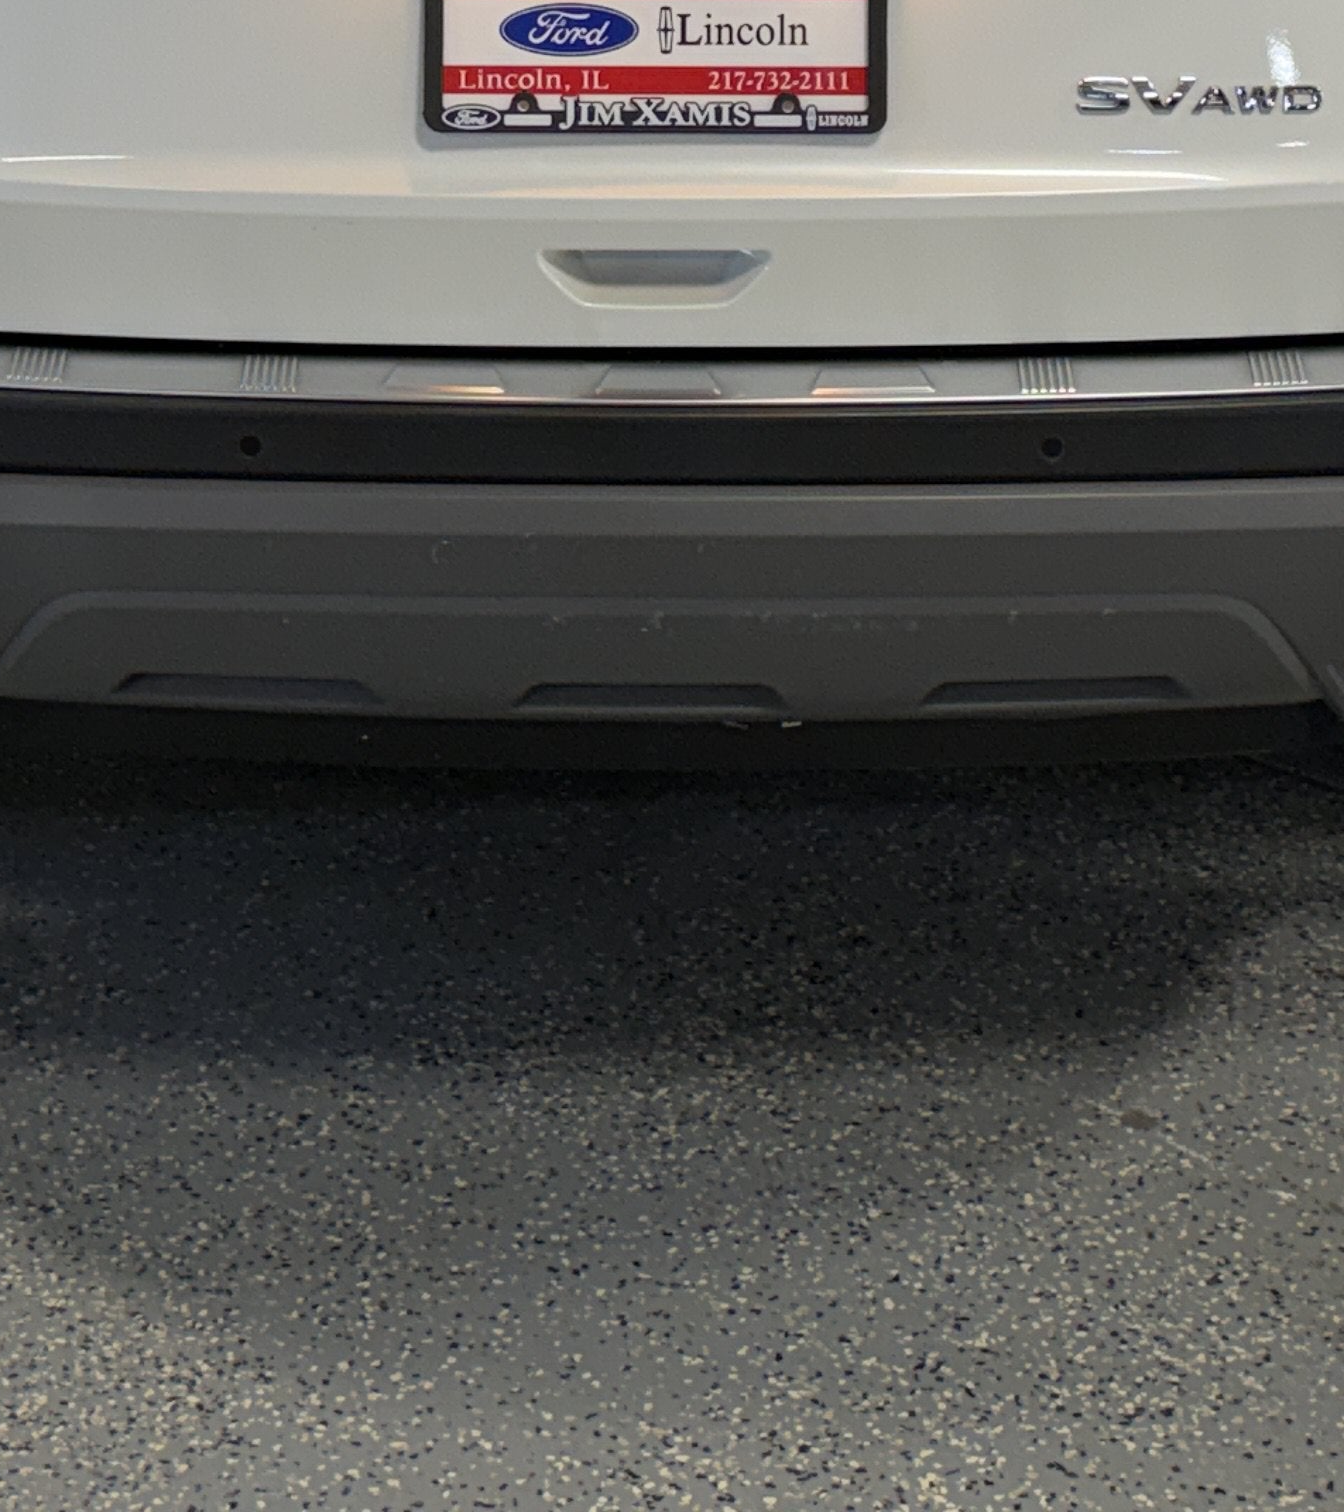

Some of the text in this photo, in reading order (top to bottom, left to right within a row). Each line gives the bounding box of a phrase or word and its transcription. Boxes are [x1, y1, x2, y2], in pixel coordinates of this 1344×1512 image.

[528, 10, 809, 47] Ford Lincoln
[458, 69, 610, 92] Lincoln, IL
[708, 71, 850, 91] 217-732-2111
[1076, 76, 1323, 115] SV AWD
[559, 96, 751, 130] JIM XAMIS
